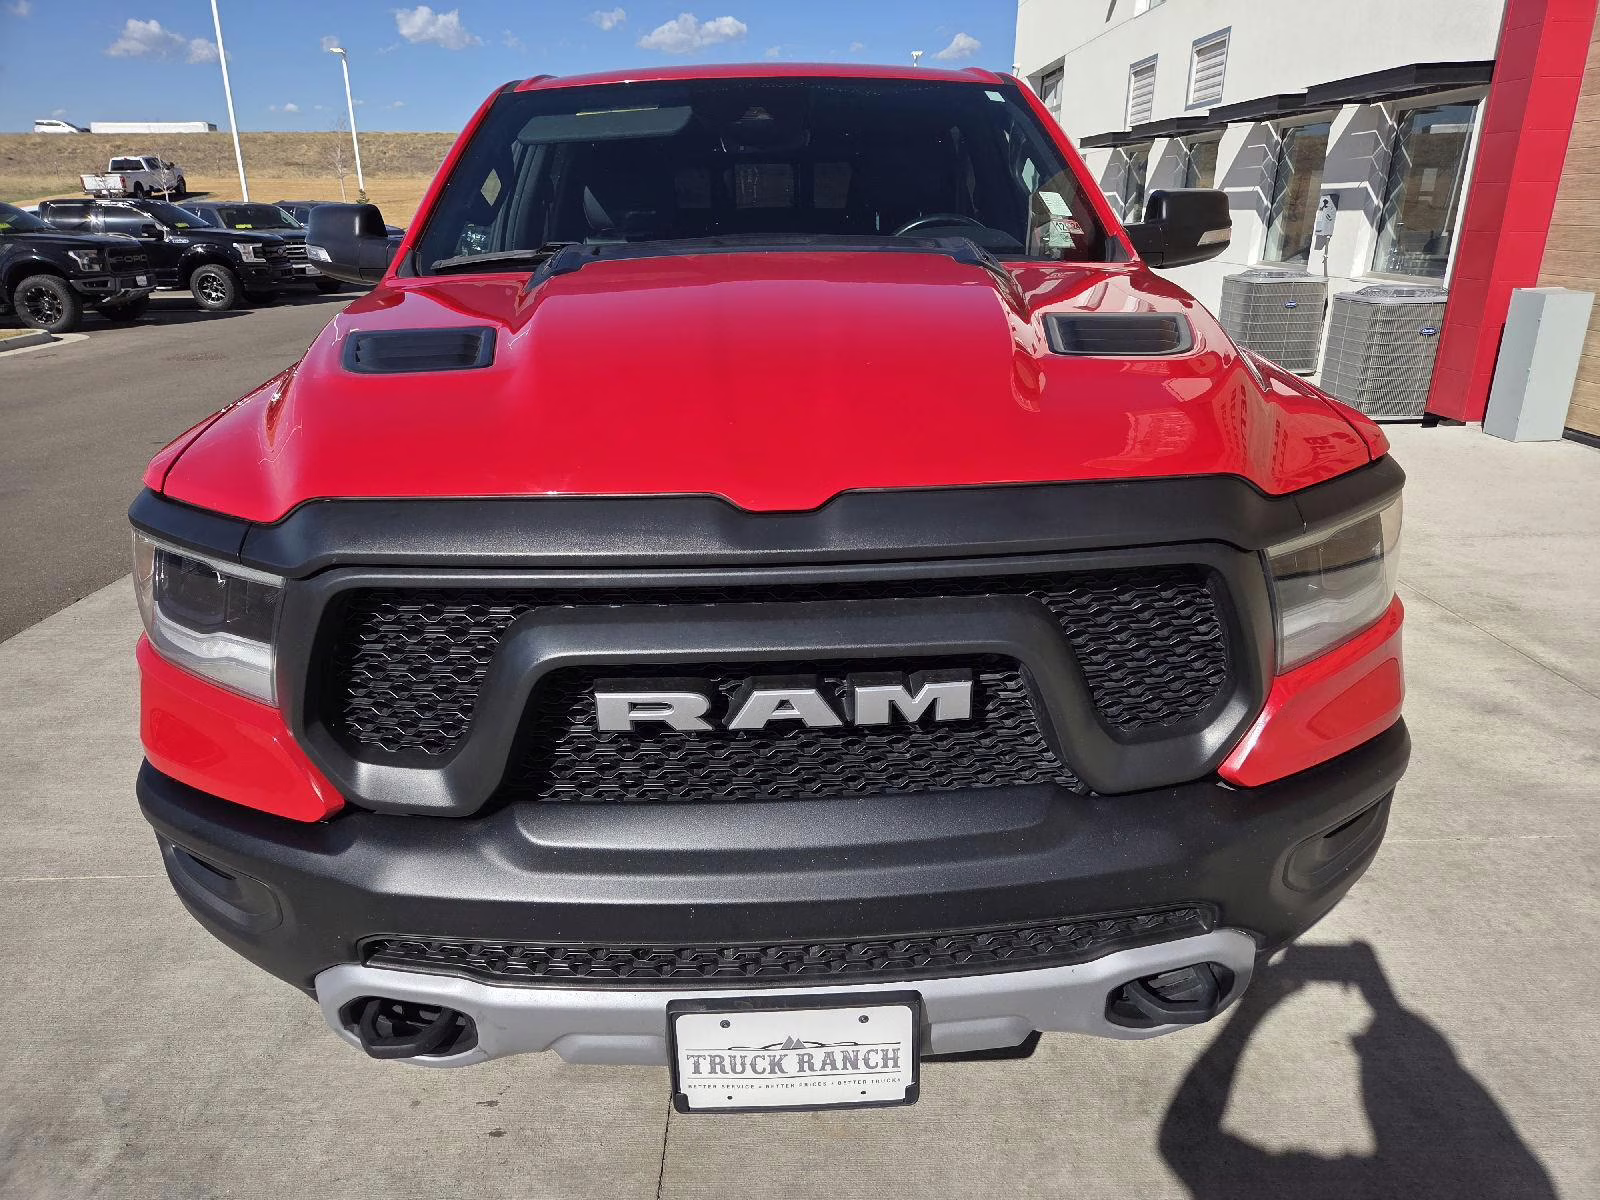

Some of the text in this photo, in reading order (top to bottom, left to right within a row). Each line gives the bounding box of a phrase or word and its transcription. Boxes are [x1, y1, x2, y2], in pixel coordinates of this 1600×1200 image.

[594, 680, 972, 731] RAM
[686, 1048, 901, 1075] TRUCK RANCH
